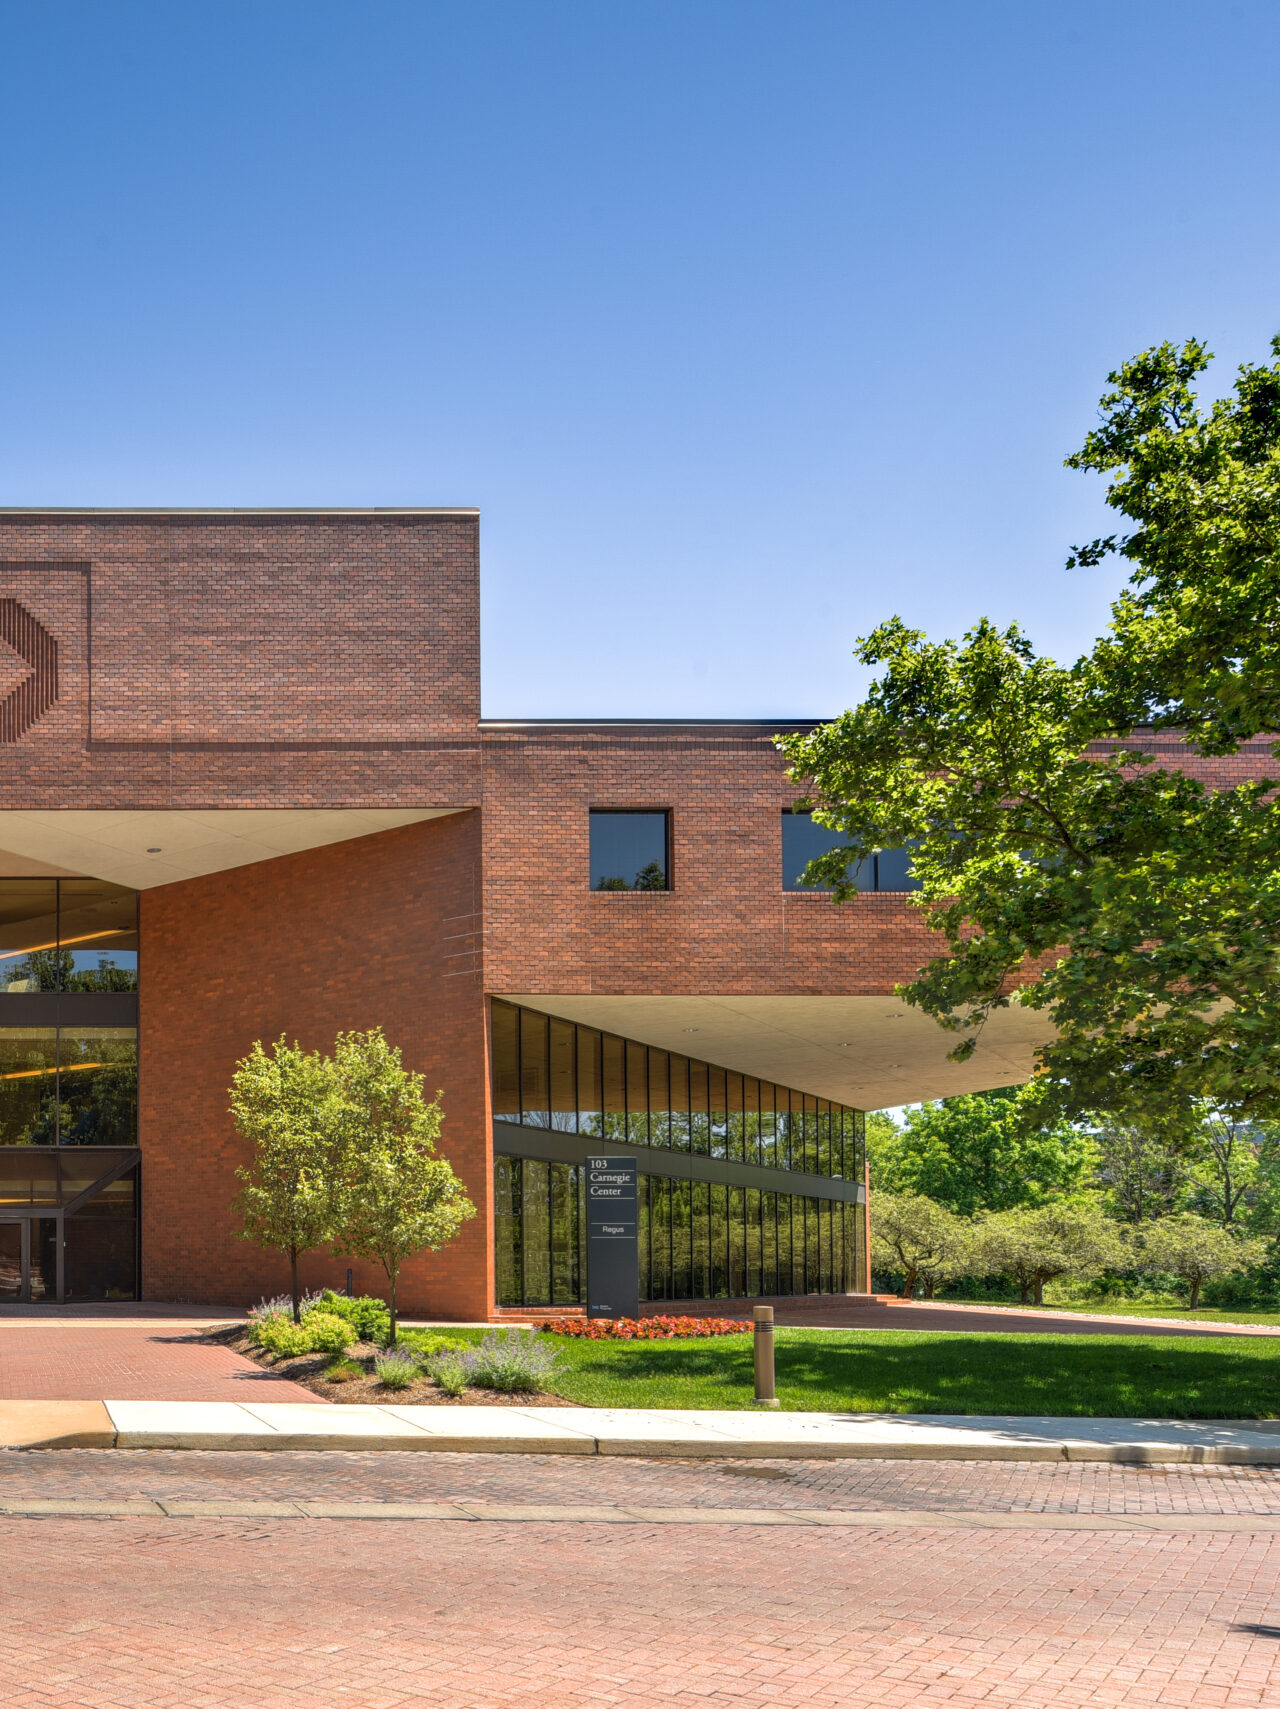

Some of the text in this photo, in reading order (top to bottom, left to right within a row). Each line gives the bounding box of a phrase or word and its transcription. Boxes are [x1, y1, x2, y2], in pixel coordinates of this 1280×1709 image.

[591, 1160, 607, 1169] 103
[590, 1172, 630, 1184] Carnegie
[590, 1186, 621, 1195] Center
[602, 1225, 624, 1235] Regus
